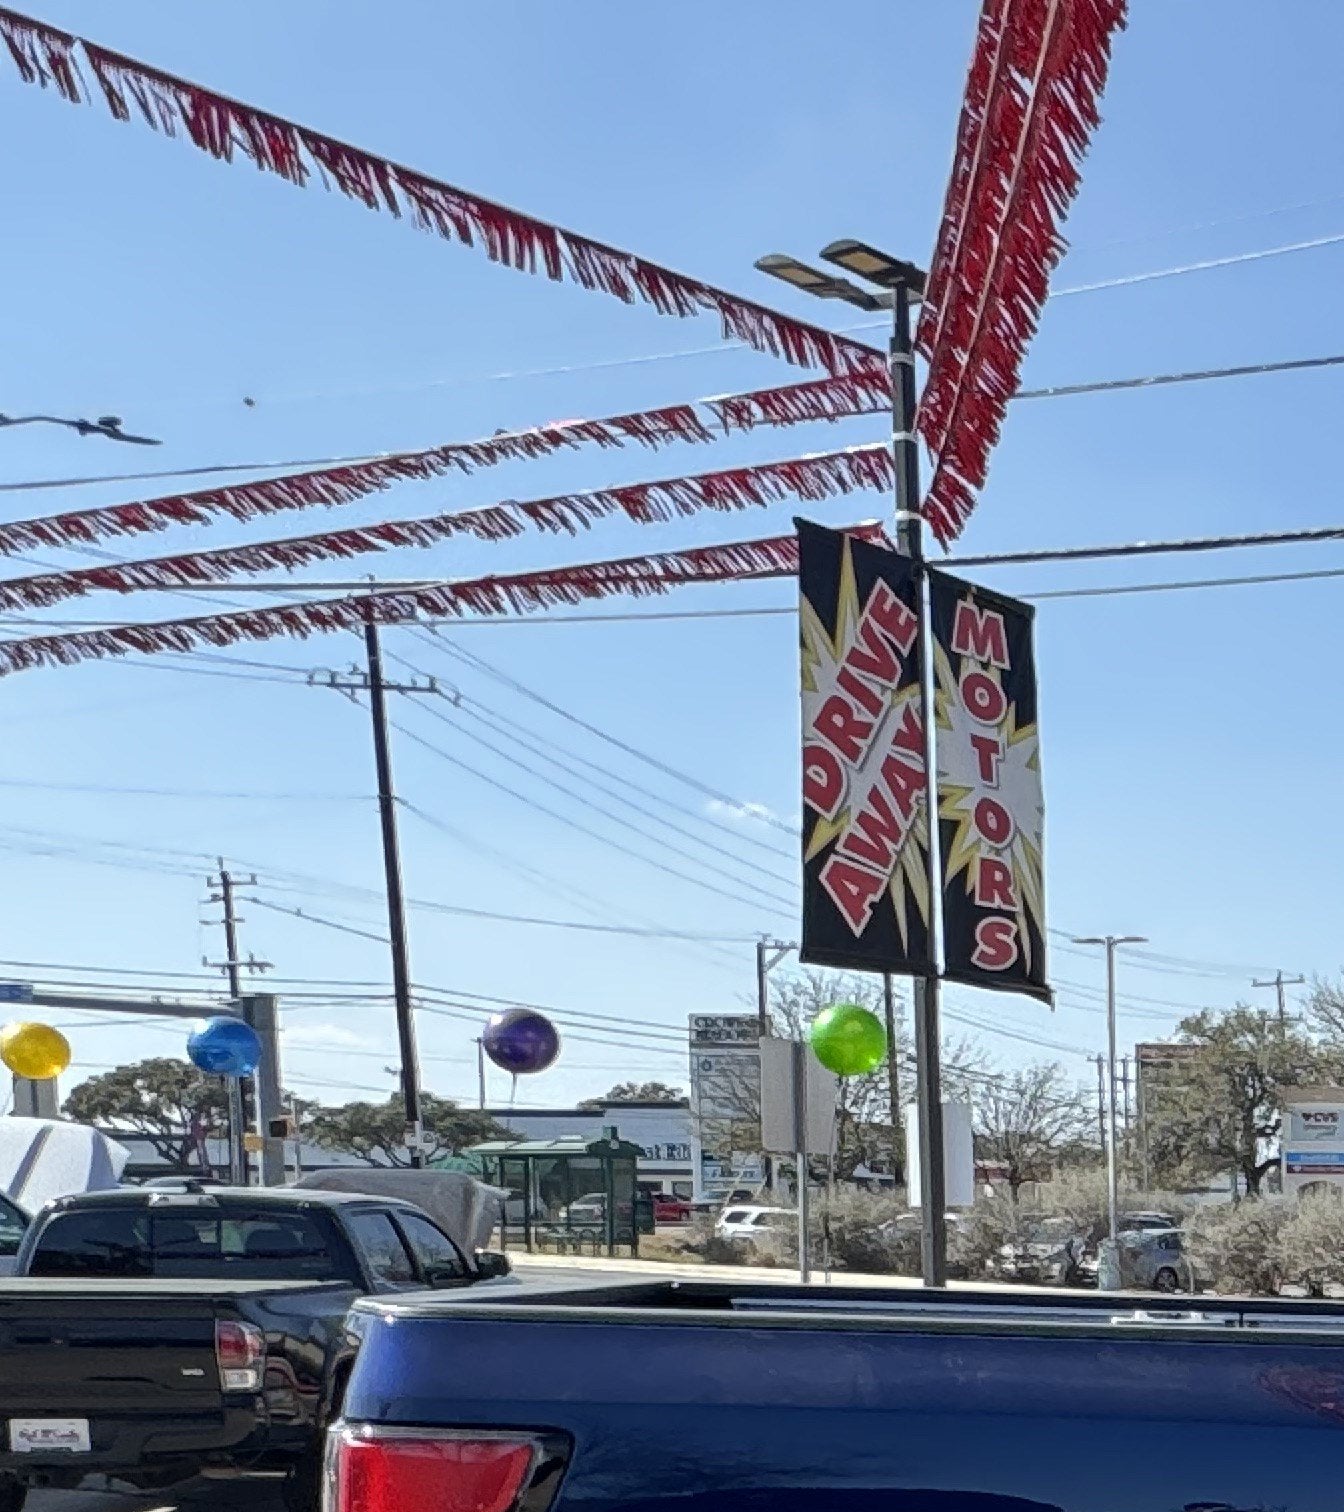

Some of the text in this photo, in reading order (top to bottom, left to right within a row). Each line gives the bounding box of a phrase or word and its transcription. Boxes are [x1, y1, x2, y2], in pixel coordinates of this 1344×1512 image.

[802, 577, 918, 819] DRIVE
[951, 600, 1017, 971] MOTORS
[818, 704, 926, 938] AWAY
